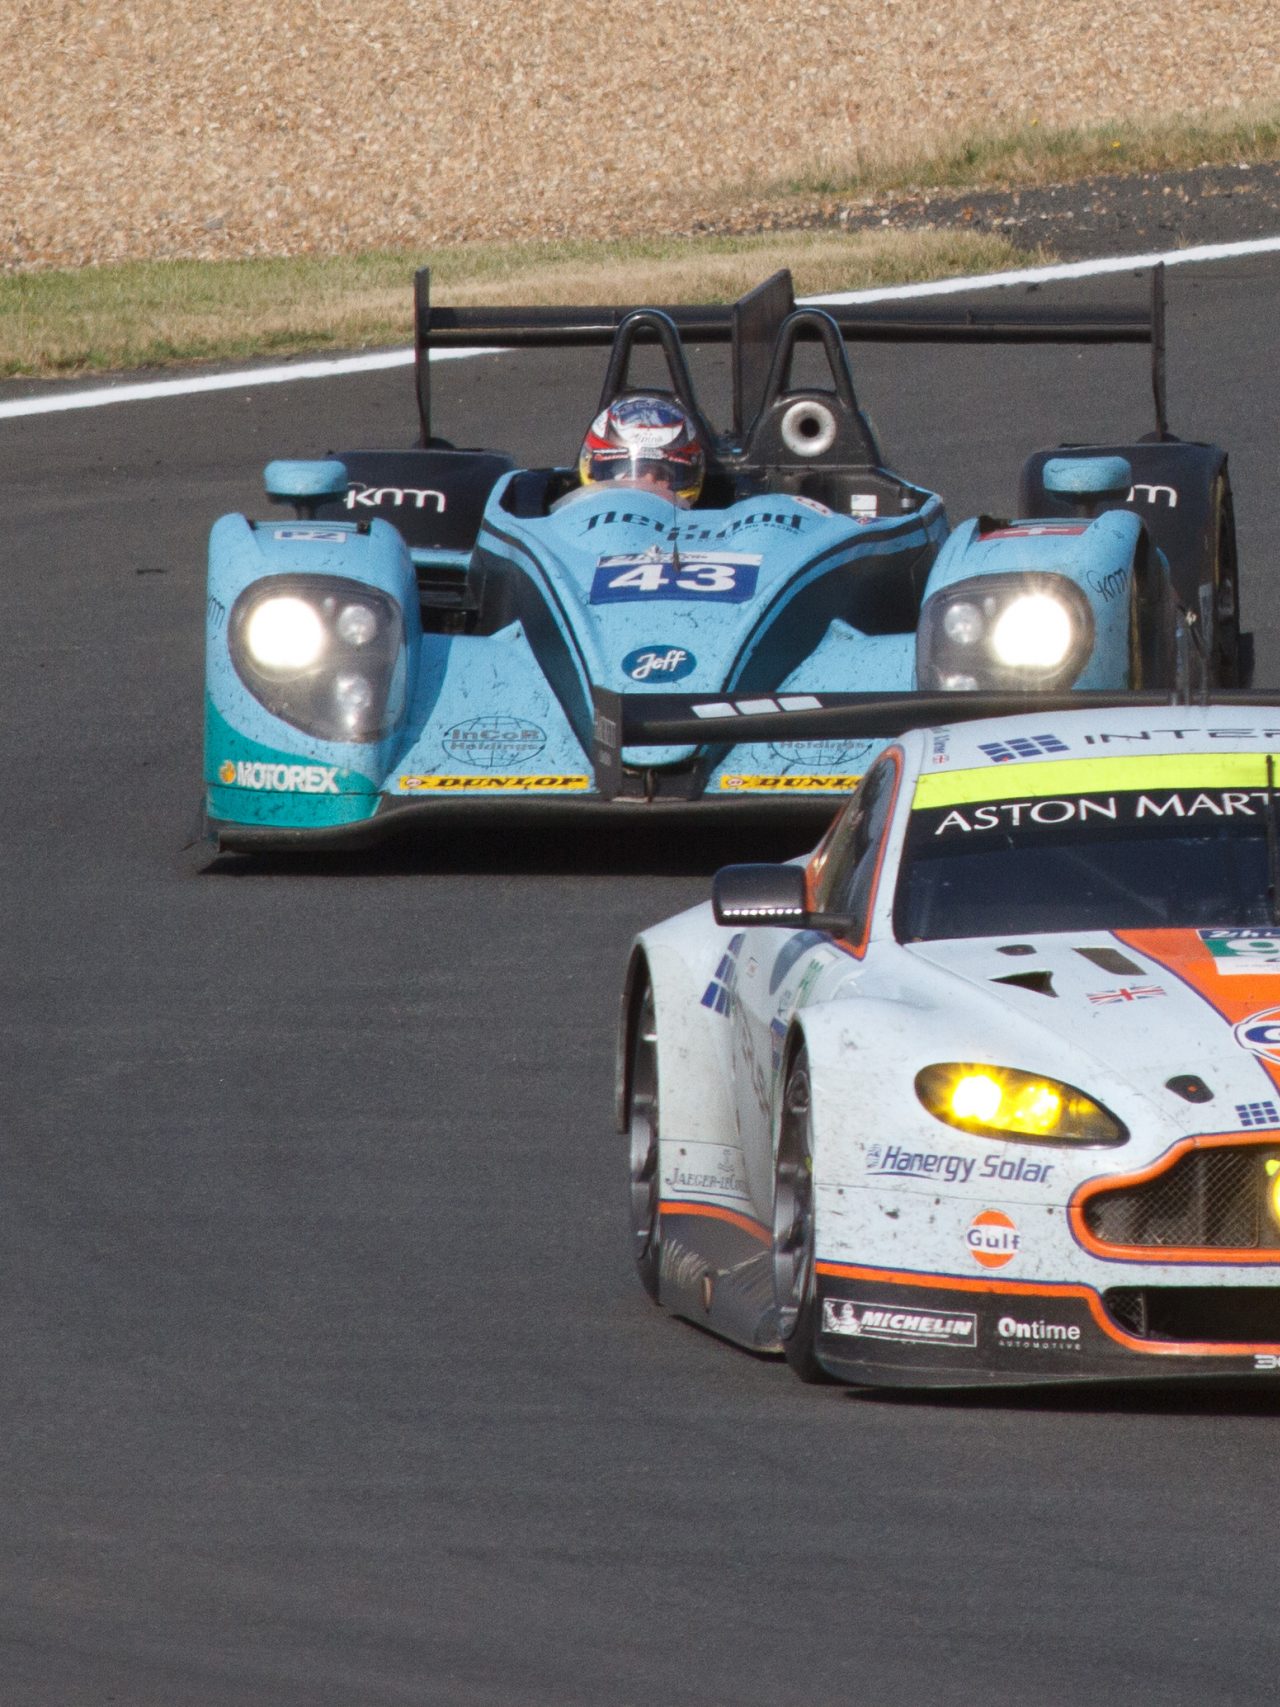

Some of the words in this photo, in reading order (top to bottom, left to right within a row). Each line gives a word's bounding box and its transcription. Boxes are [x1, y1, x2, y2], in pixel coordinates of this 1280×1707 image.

[608, 564, 736, 591] 43
[632, 650, 687, 679] Jeff
[236, 761, 341, 794] MOTOREX
[429, 777, 585, 789] DUNLOP
[934, 797, 1116, 835] ASTON
[881, 1146, 976, 1183] Hanergy
[979, 1155, 1054, 1183] Solar
[967, 1229, 1021, 1250] Gulf
[861, 1311, 973, 1336] MICHELIN
[998, 1317, 1080, 1340] Ontime
